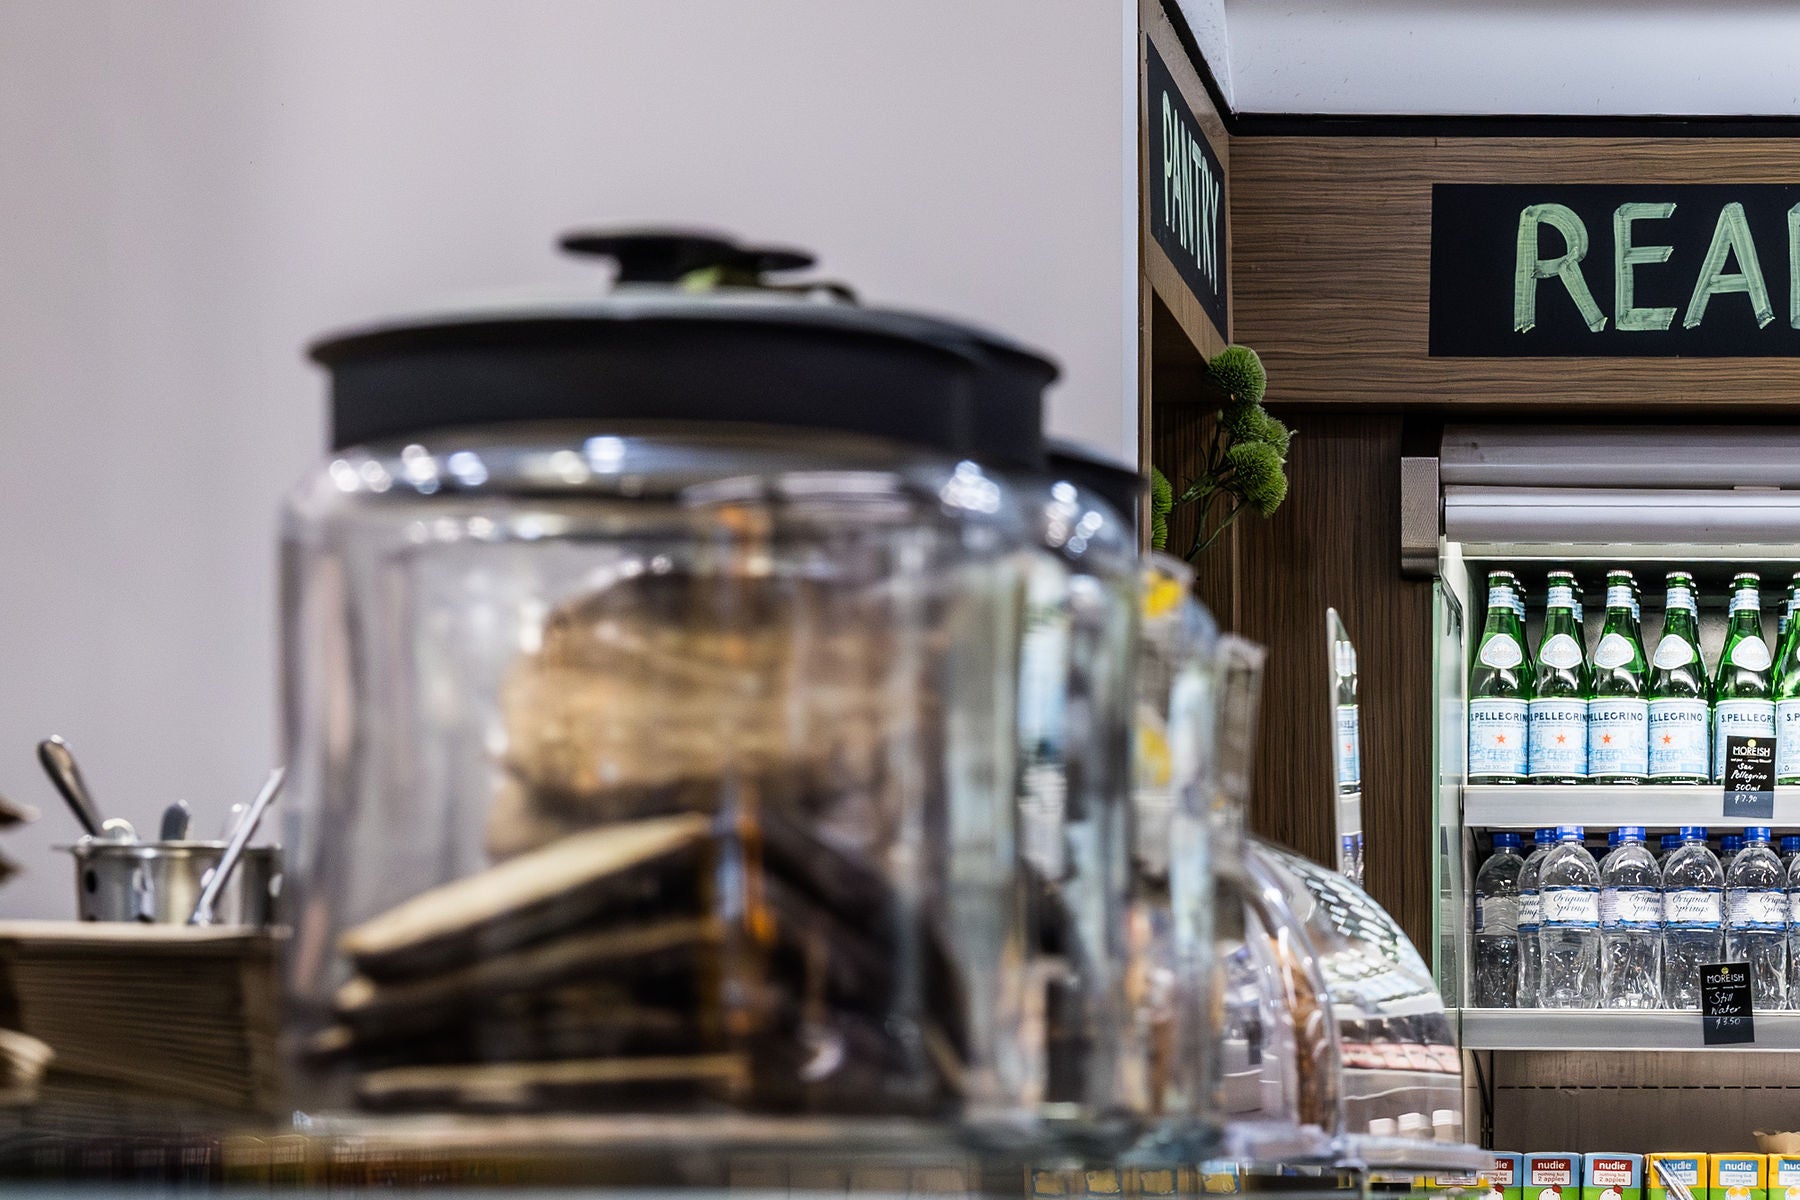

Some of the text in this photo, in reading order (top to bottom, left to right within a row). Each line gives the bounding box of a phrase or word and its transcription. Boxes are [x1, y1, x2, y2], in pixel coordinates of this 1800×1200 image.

[1162, 90, 1220, 296] PANTRY
[1732, 746, 1770, 757] MOREISH
[1707, 973, 1744, 984] MOREISH
[1711, 1005, 1742, 1015] Water
[1538, 1161, 1566, 1169] nudie
[1599, 1161, 1627, 1170] nudie
[1725, 1162, 1753, 1171] nudie
